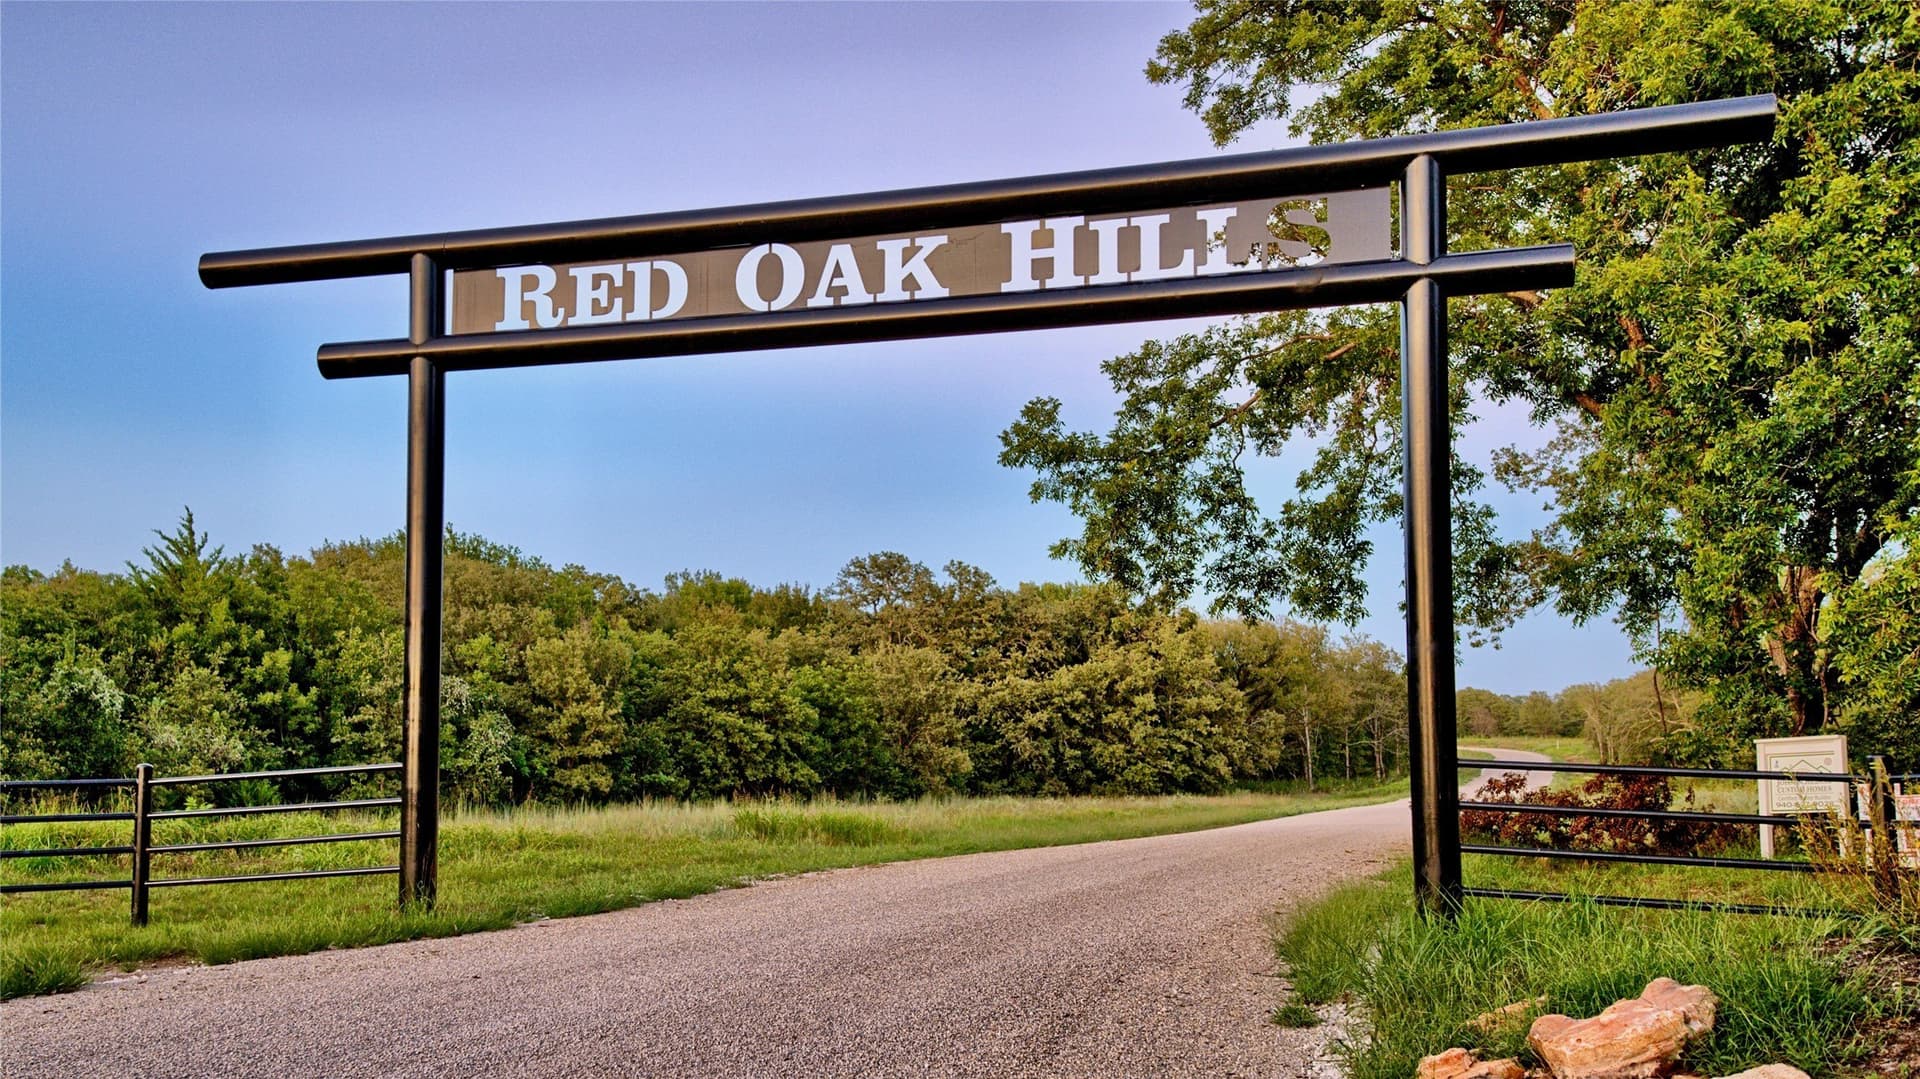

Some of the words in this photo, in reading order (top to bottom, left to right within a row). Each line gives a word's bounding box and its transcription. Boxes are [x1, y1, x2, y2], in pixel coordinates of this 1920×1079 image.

[495, 260, 688, 331] RED
[735, 234, 950, 312] OAK
[1001, 197, 1332, 293] HILLS
